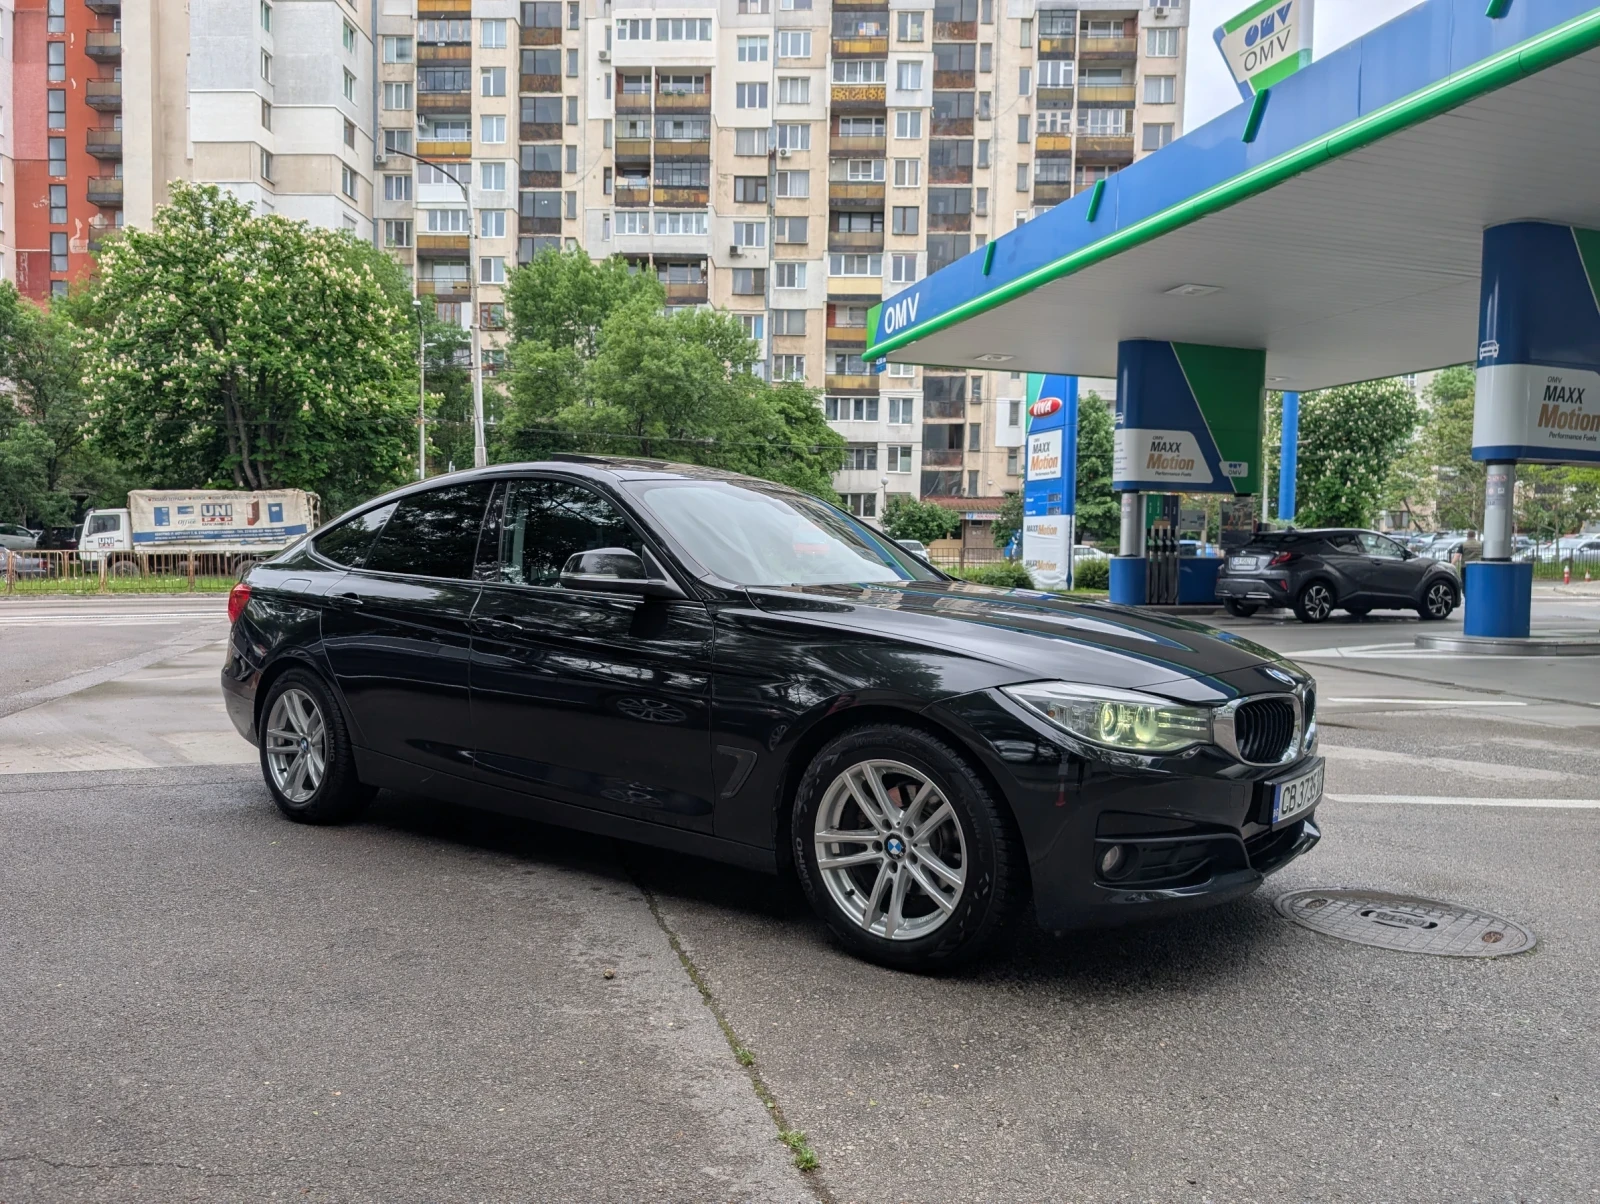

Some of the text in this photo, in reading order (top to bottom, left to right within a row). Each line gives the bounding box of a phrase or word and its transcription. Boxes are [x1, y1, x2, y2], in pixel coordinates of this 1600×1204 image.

[1244, 28, 1291, 71] OMV
[884, 292, 920, 334] OMV
[1543, 385, 1586, 404] MAXX
[1033, 399, 1053, 415] VIVA
[1537, 403, 1600, 432] Motion
[1548, 431, 1582, 440] Performance
[1032, 441, 1051, 454] MAXX
[1150, 441, 1182, 453] MAXX
[1030, 454, 1058, 471] Motion
[1146, 453, 1195, 470] Motion
[202, 504, 232, 516] UNI
[178, 518, 196, 526] Office
[1282, 784, 1297, 814] CB
